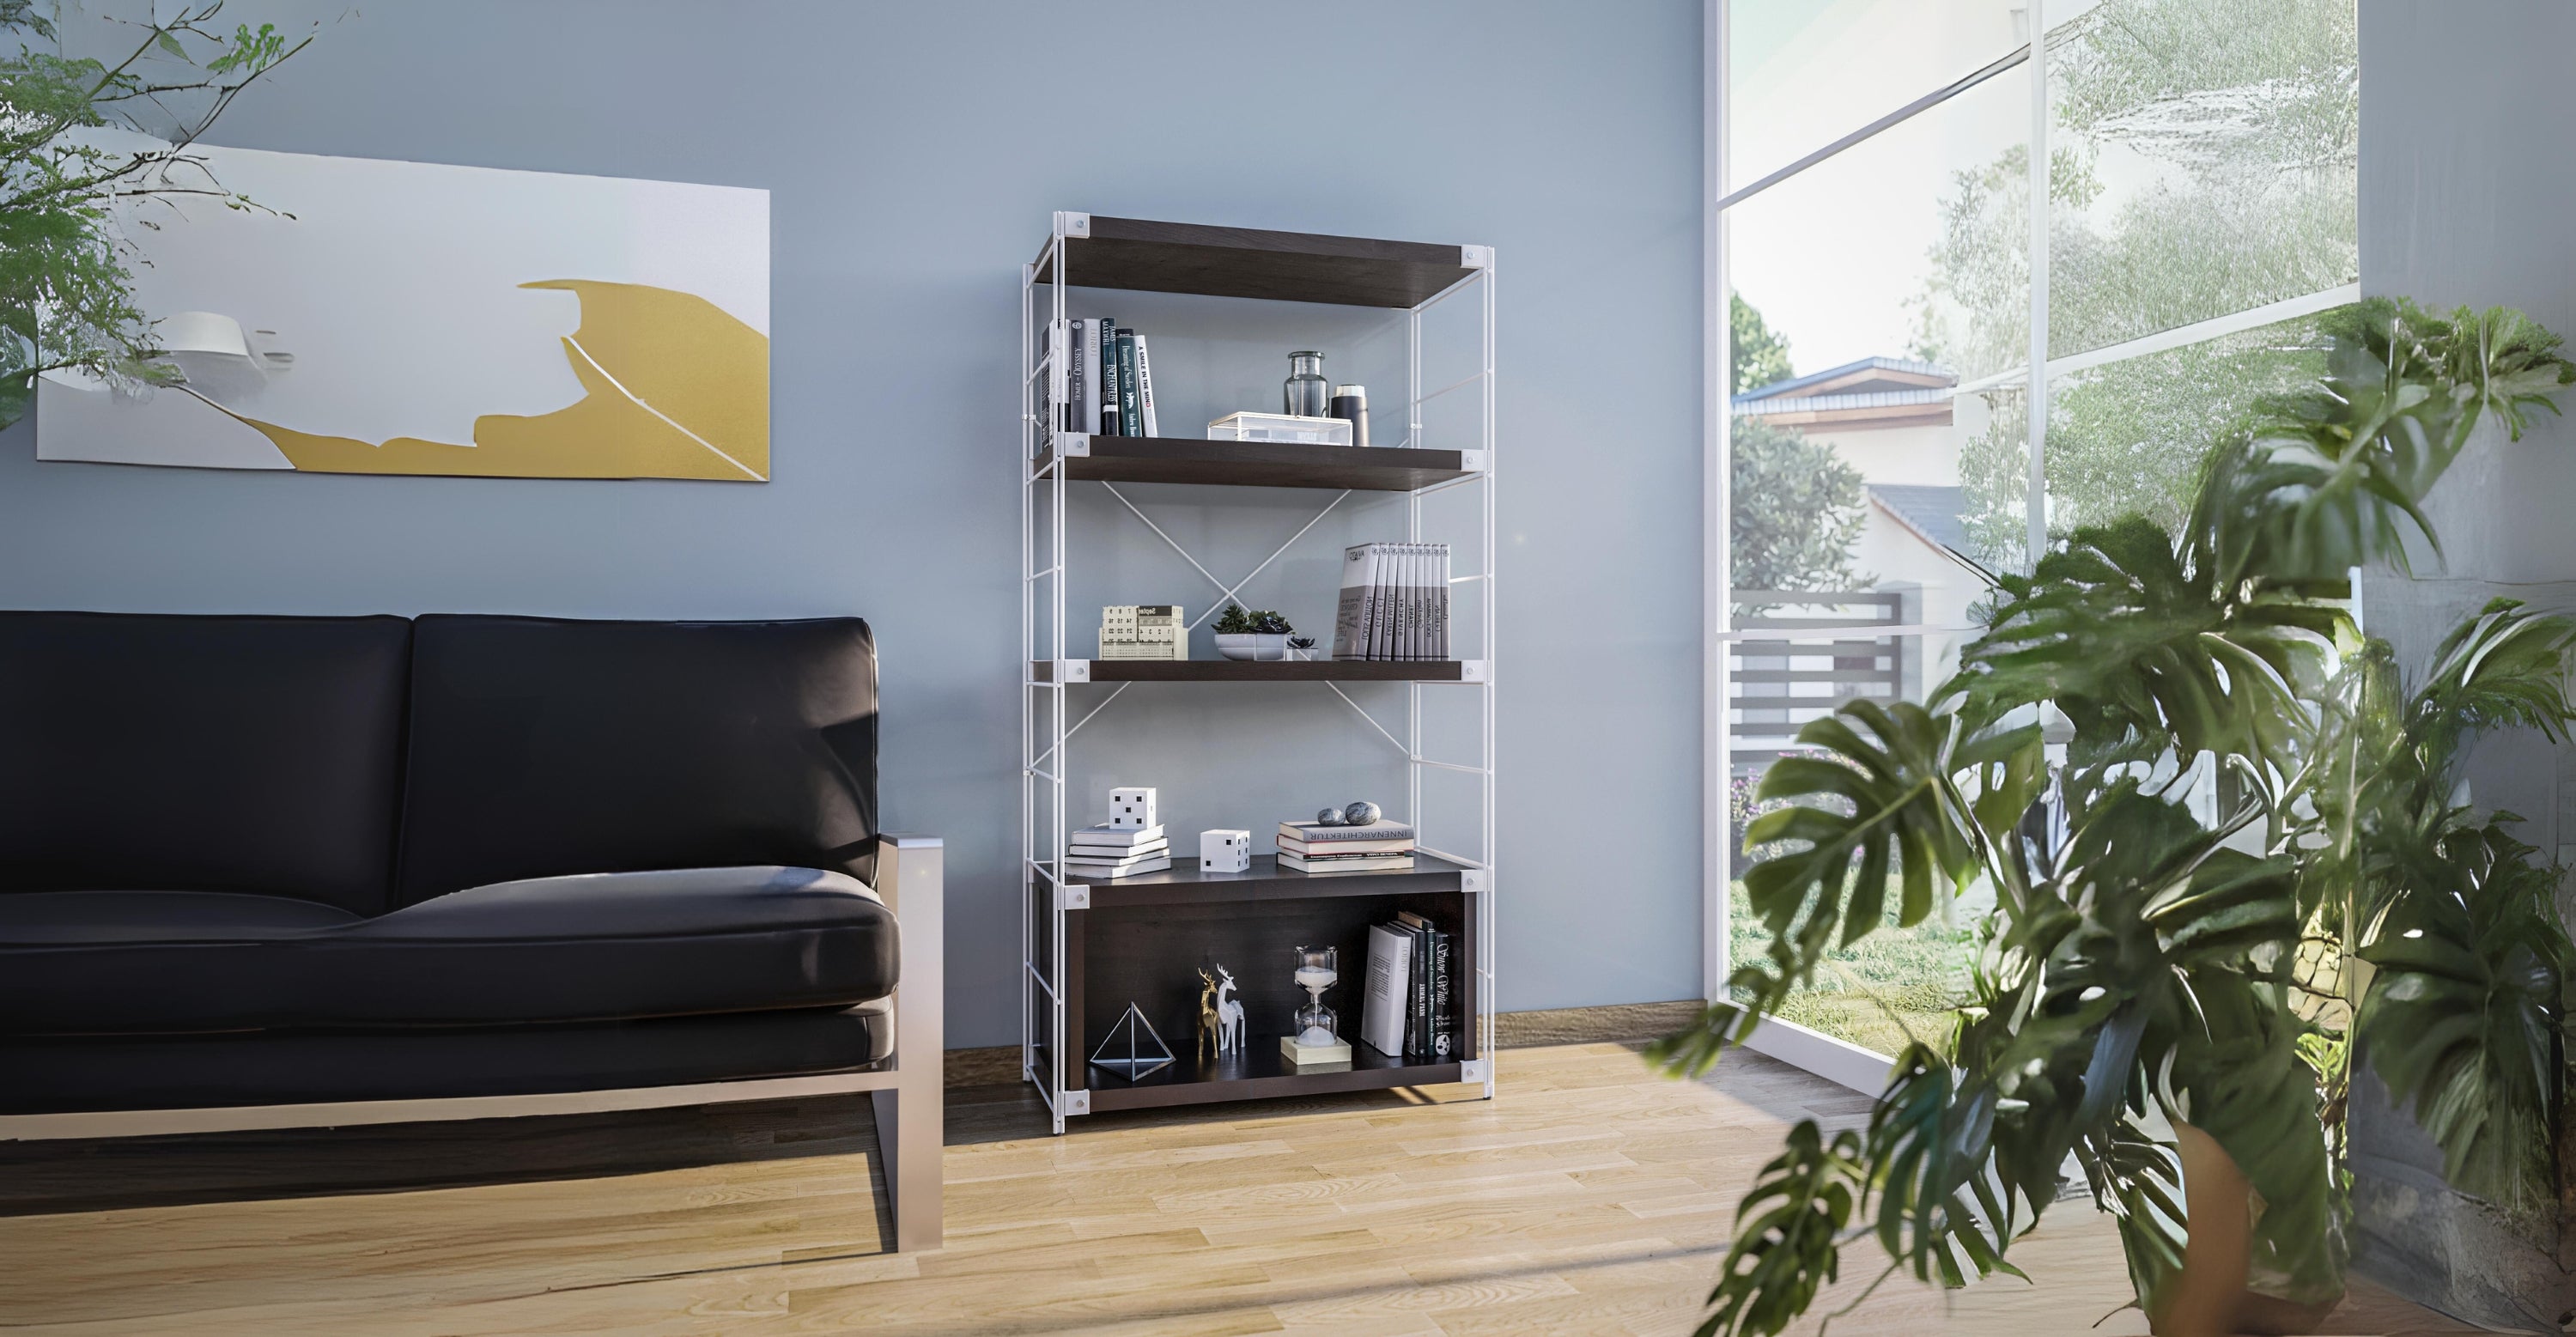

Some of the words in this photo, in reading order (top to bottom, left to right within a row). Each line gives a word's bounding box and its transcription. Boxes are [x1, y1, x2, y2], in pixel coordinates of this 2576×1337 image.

[1121, 345, 1131, 367] Dreaming
[1107, 364, 1117, 402] ENCHANTRESS
[1310, 830, 1407, 840] INNENARCHITEKTUR
[1437, 943, 1449, 973] Snow
[1437, 975, 1449, 1005] White
